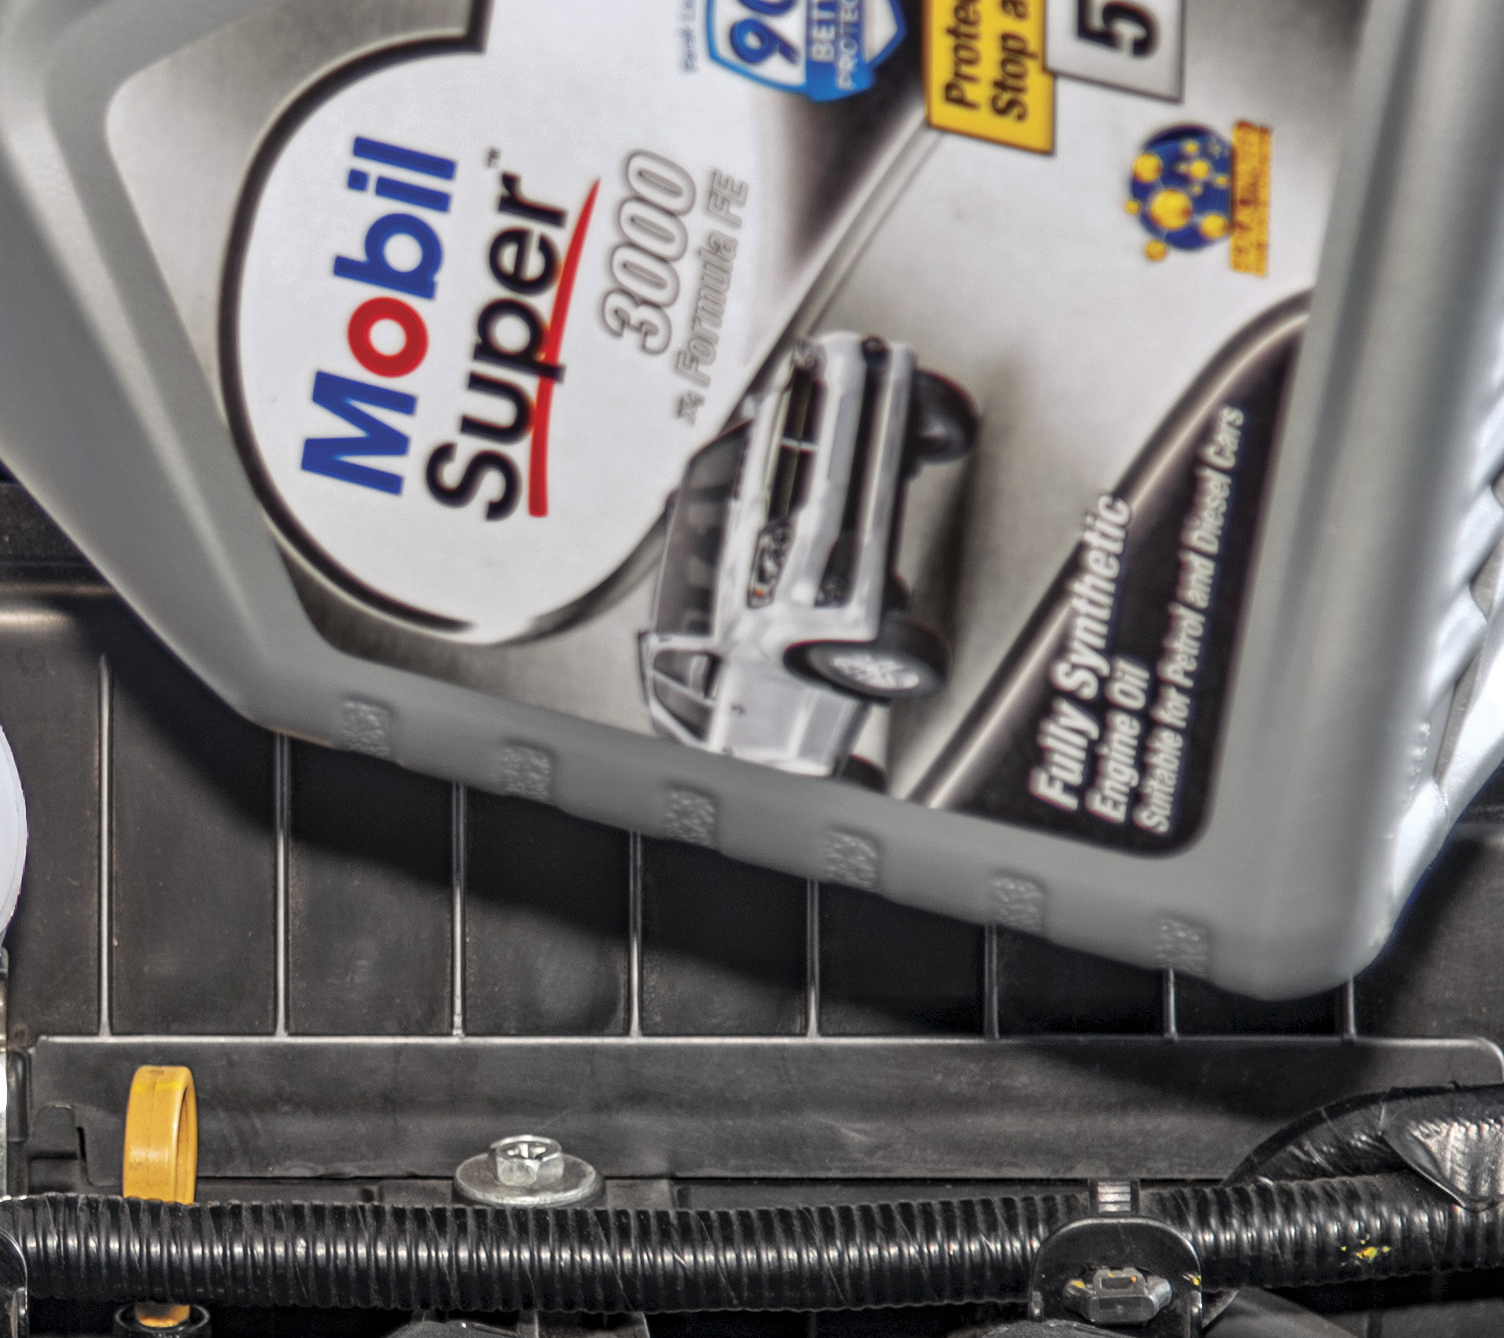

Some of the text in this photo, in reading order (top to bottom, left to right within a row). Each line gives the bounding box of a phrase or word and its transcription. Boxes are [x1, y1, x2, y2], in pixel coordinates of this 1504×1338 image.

[991, 39, 1039, 122] Stop
[602, 149, 696, 355] 3000
[705, 168, 749, 228] FE
[301, 136, 458, 496] Mobil
[673, 229, 739, 388] Formula
[1034, 495, 1131, 810] Fully Synthetic
[1134, 407, 1244, 834] Suitable for Petrol and Diesel Cars
[1087, 657, 1150, 823] Engine Oil
